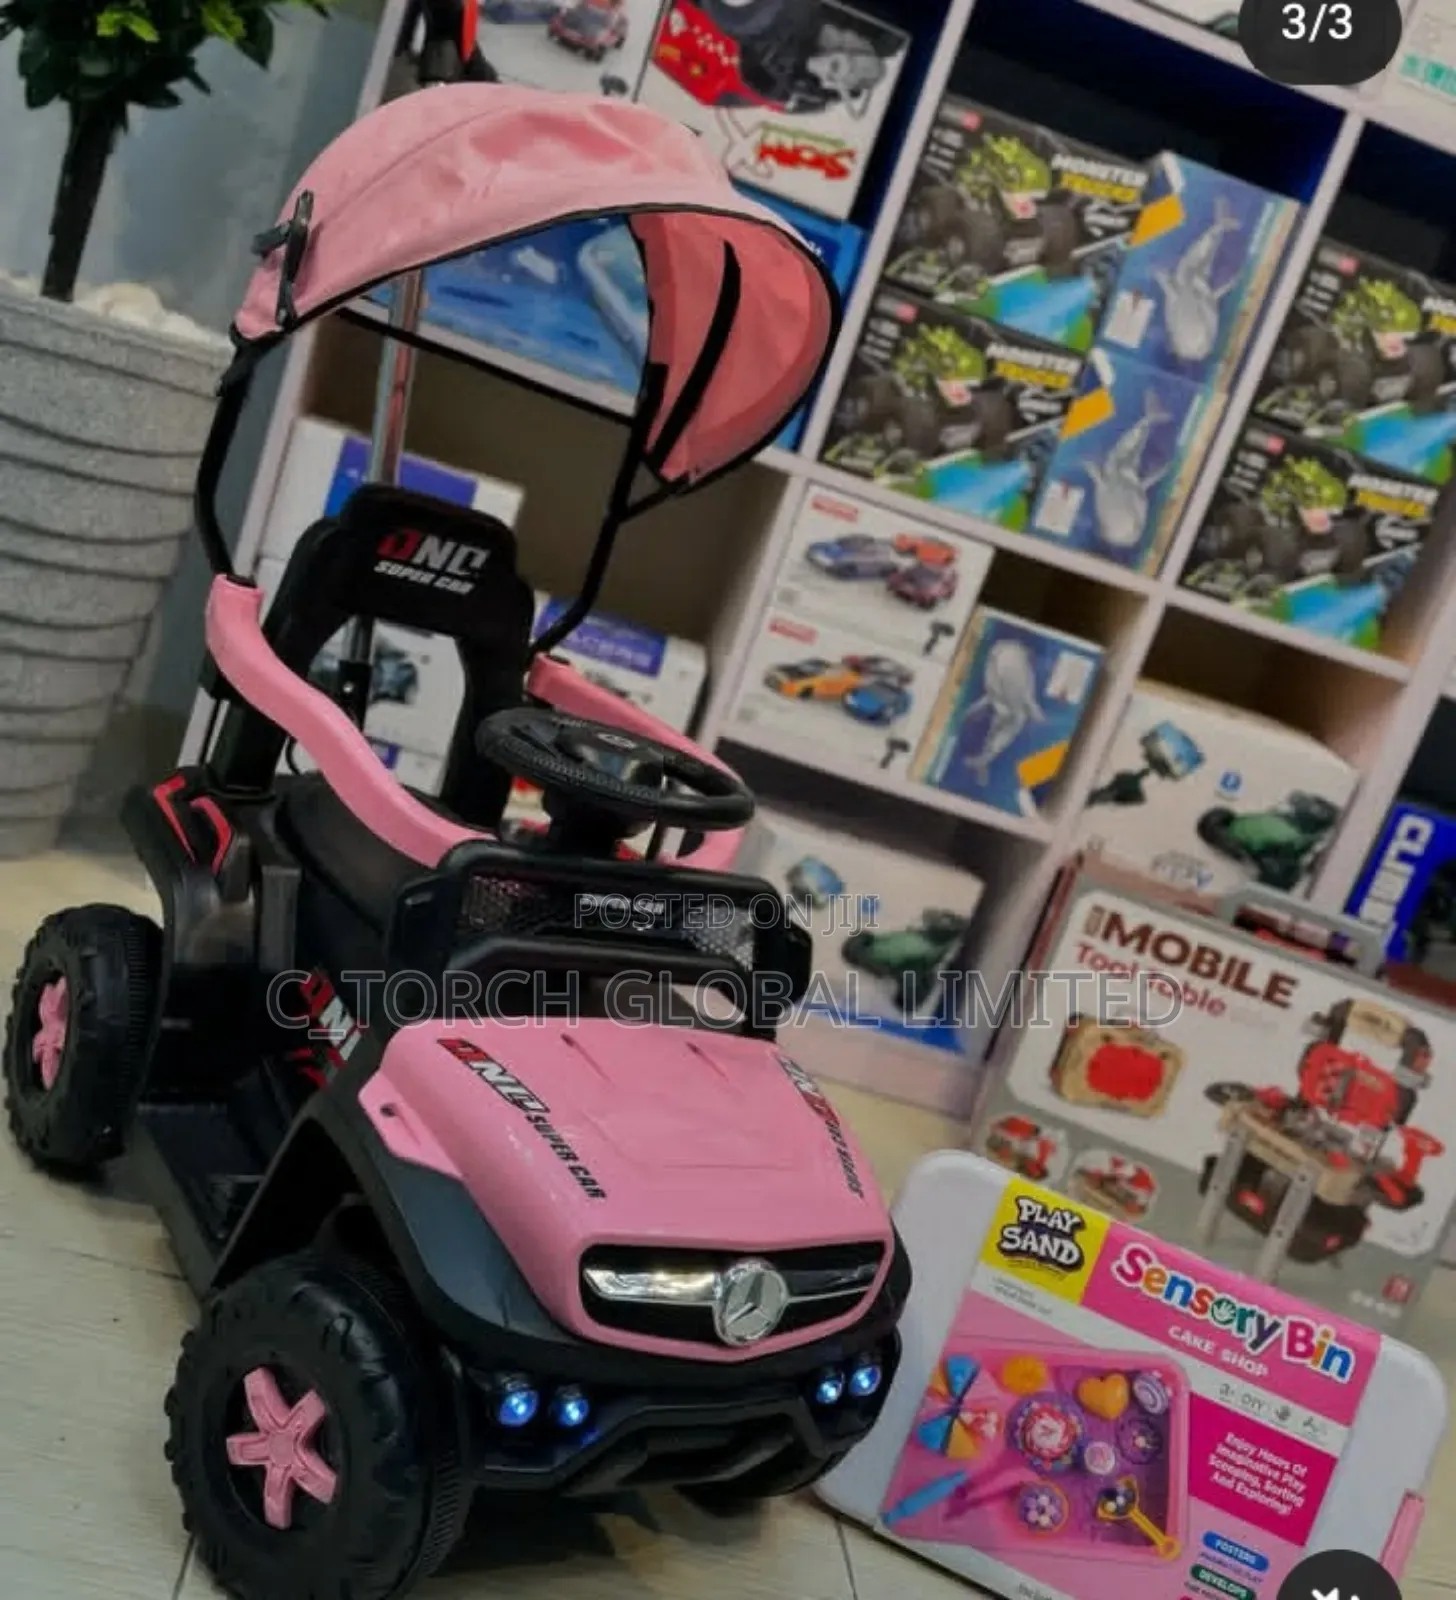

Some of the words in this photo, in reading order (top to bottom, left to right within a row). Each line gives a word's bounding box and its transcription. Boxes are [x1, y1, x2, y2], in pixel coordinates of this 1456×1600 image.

[374, 560, 436, 585] SUPER
[433, 576, 476, 595] CAR
[1076, 942, 1139, 982] Tool
[1146, 968, 1227, 1017] Table
[1101, 911, 1299, 1010] MOBILE
[525, 1114, 580, 1162] SUPER
[568, 1164, 608, 1199] CAR
[1016, 1197, 1084, 1234] PLAY
[998, 1225, 1083, 1268] SAND
[1112, 1243, 1281, 1354] Sensory
[1284, 1317, 1354, 1383] Bin
[1168, 1325, 1215, 1355] CAKE
[1221, 1349, 1268, 1377] SHOP
[1225, 1432, 1258, 1456] Enjoy
[1211, 1471, 1235, 1489] And
[1264, 1480, 1304, 1508] Sorting
[1282, 1472, 1306, 1493] Play
